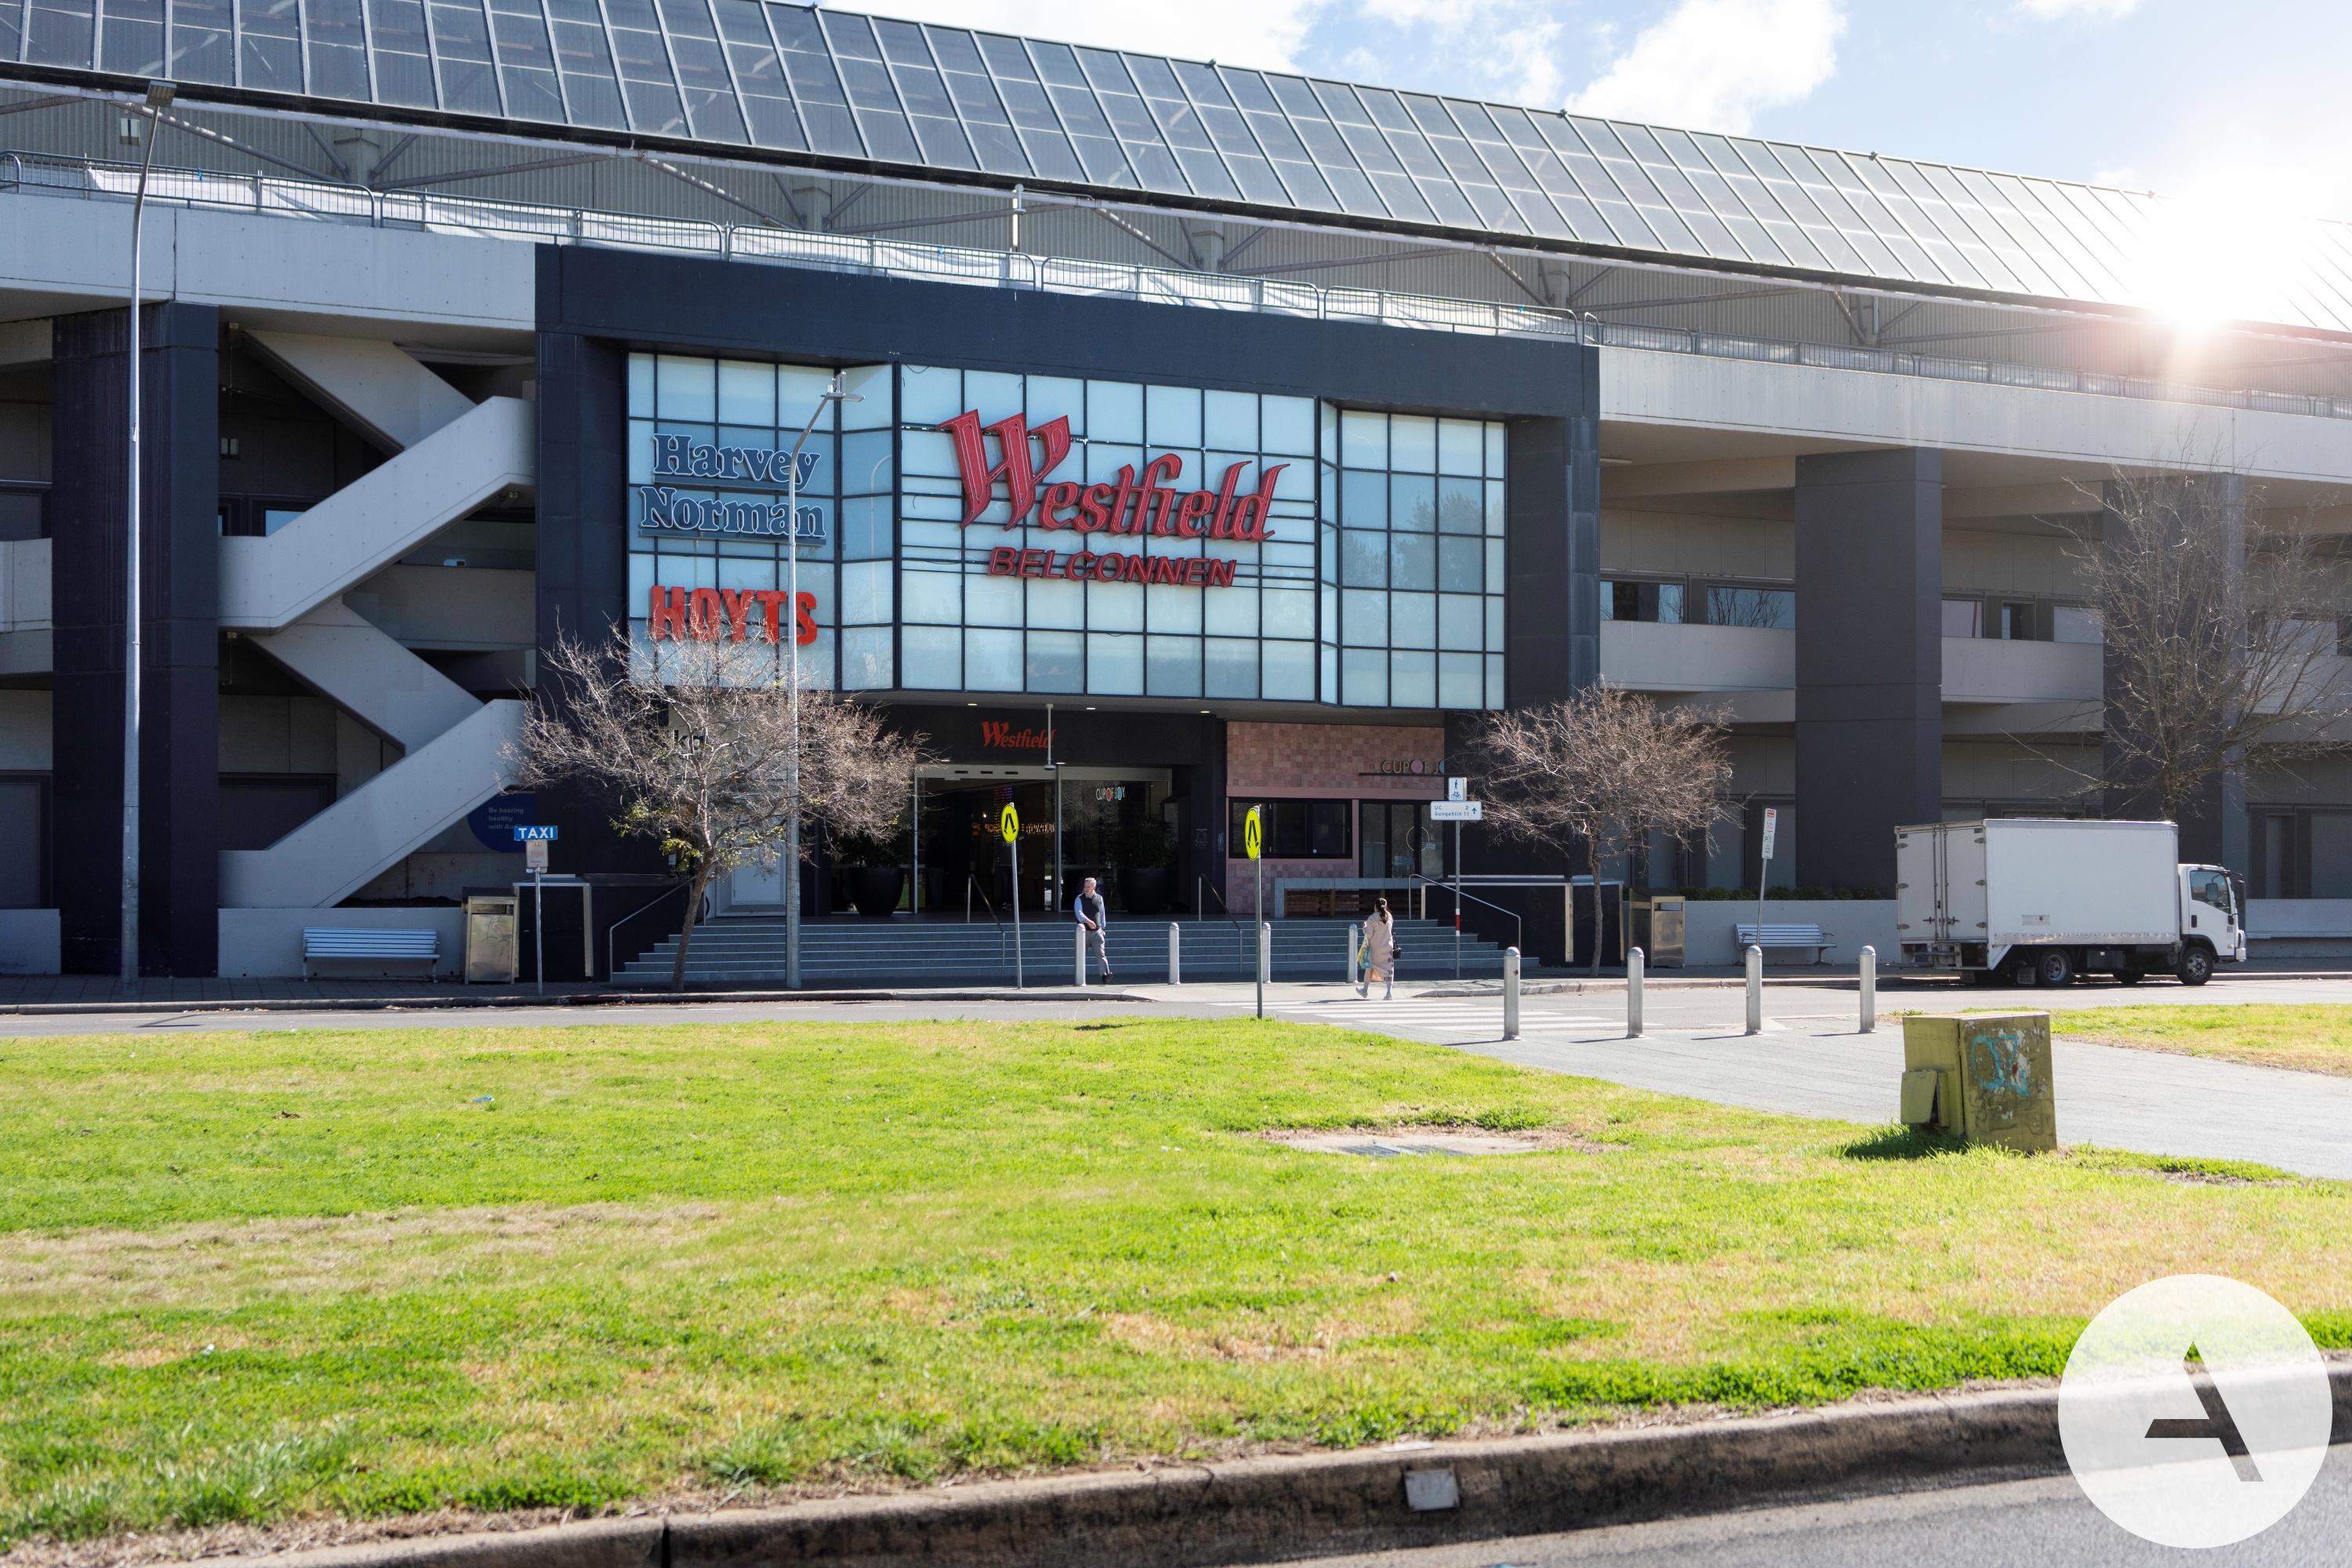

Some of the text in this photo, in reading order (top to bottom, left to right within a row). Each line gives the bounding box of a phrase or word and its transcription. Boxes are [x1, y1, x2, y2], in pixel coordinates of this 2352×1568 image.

[652, 434, 821, 492] Harvey
[937, 408, 1290, 542] Westfield
[640, 486, 826, 537] Norman
[987, 546, 1238, 588] BELCONNEN
[652, 585, 817, 645] HOYTS
[980, 720, 1058, 749] Westfield
[1381, 760, 1410, 774] CUP
[1096, 788, 1106, 800] CUP
[1115, 786, 1126, 800] JOY
[518, 827, 554, 839] TAXI
